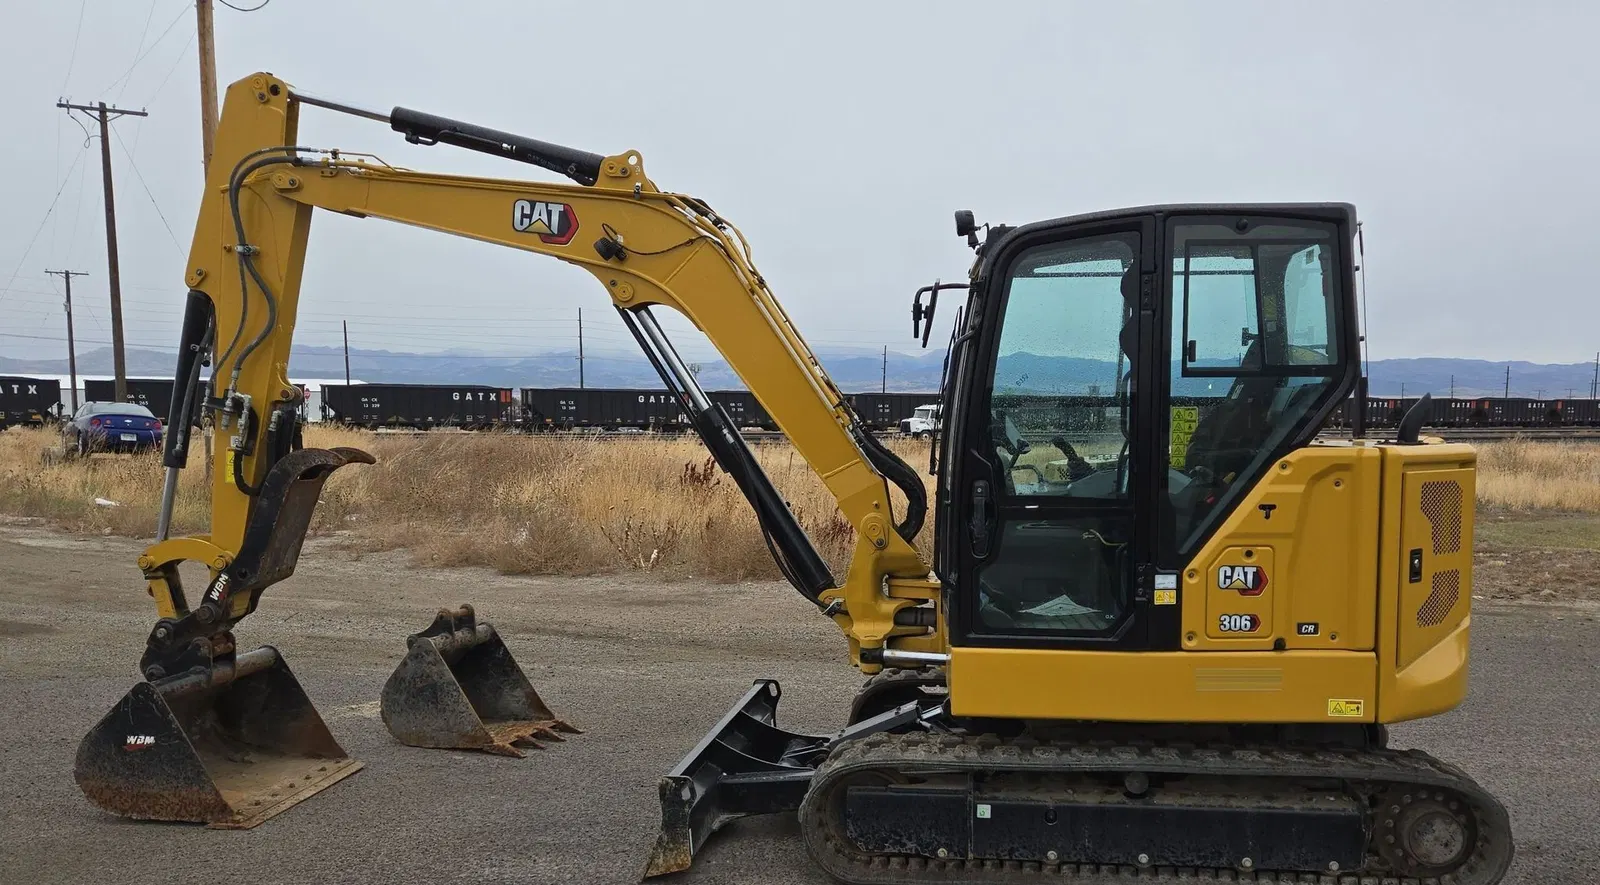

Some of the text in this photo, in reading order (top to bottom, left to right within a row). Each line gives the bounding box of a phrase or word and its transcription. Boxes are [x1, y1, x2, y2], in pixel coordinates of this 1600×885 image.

[513, 199, 564, 235] CAT
[452, 392, 497, 401] GATX
[638, 395, 676, 404] GATX
[1219, 566, 1257, 589] CAT
[209, 573, 229, 601] WBM
[1220, 615, 1251, 631] 306
[1301, 624, 1316, 634] CR
[126, 735, 156, 745] WBM
